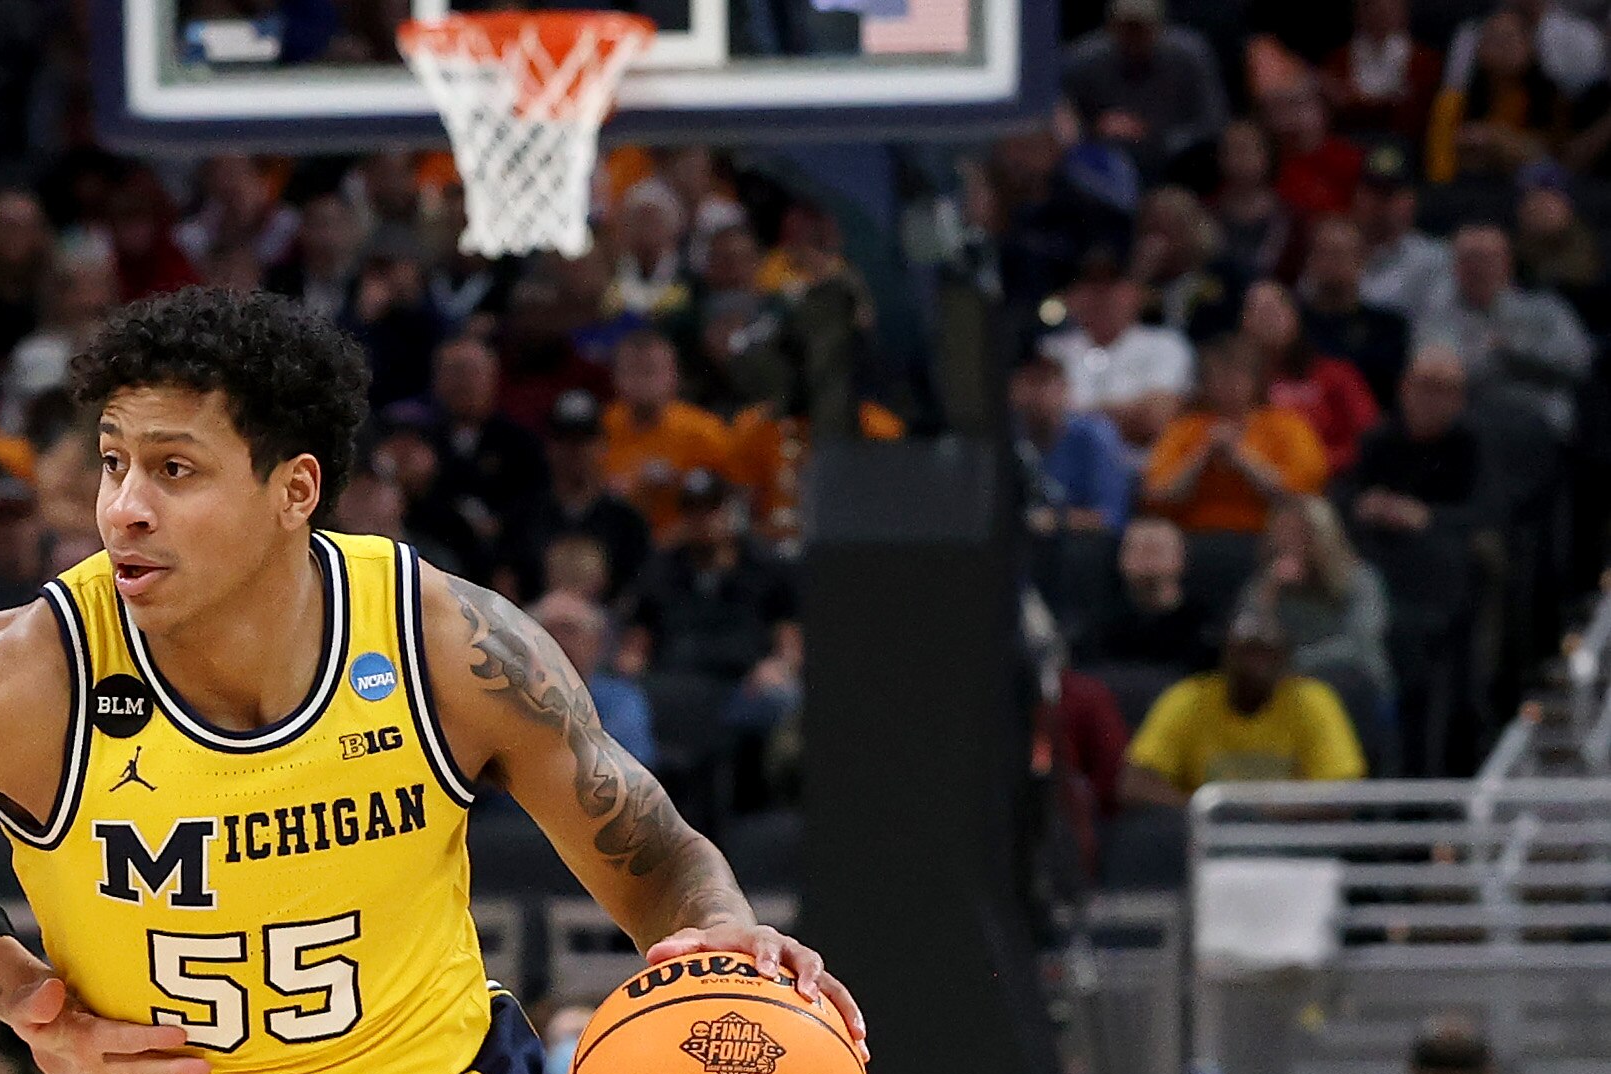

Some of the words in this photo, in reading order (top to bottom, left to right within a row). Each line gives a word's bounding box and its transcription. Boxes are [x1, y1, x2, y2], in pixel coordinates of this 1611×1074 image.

[357, 672, 395, 690] NCAA
[97, 695, 145, 716] BLM
[91, 783, 428, 911] MICHIGAN
[146, 910, 362, 1054] 55
[734, 978, 763, 987] NXT
[710, 1021, 762, 1042] FINAL
[708, 1041, 762, 1062] FOUR
